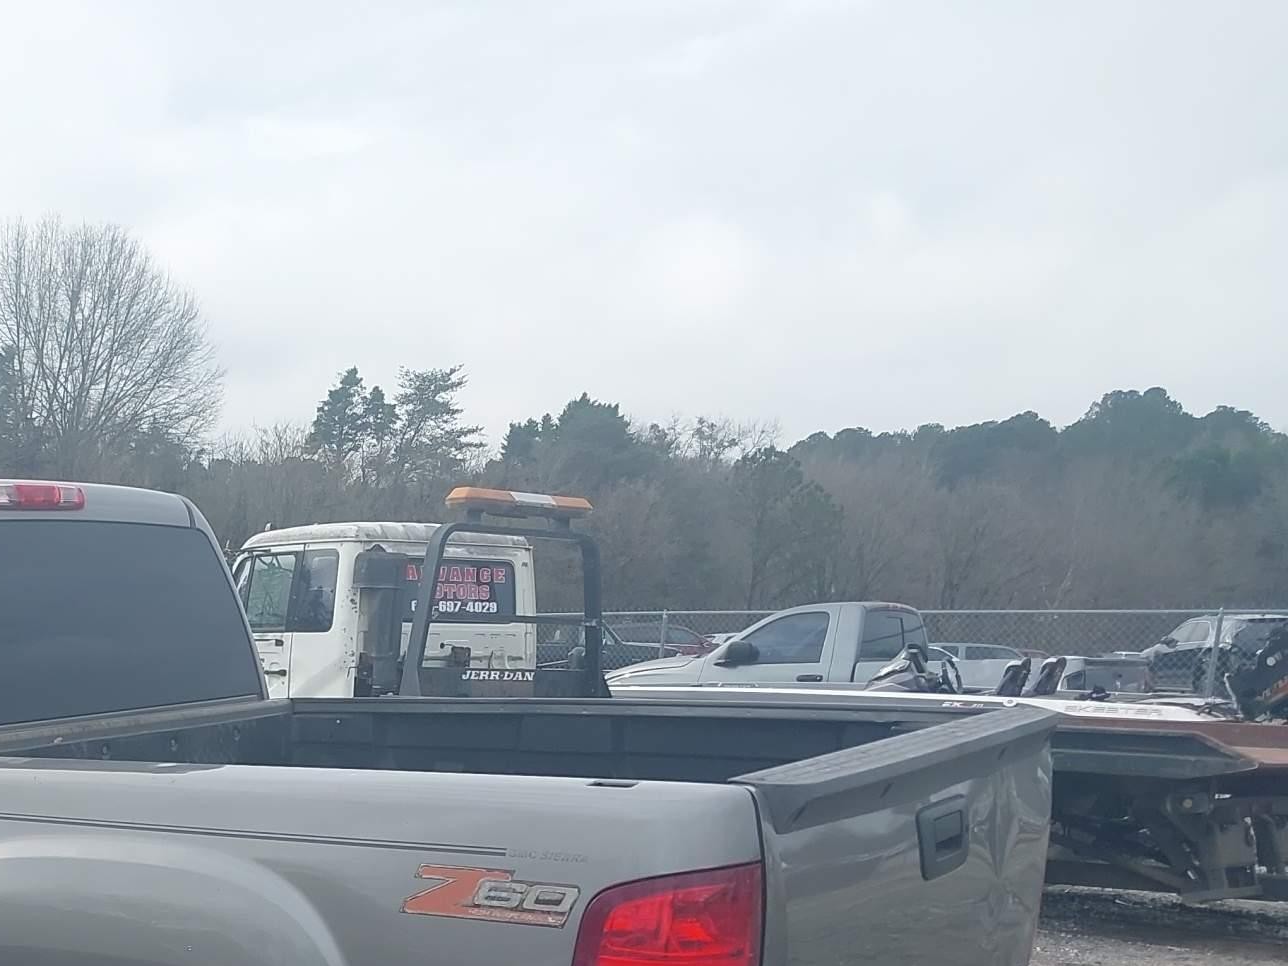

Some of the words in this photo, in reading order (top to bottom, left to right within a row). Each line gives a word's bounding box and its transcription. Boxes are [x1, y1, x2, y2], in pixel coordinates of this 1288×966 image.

[406, 564, 505, 583] AVANCE
[420, 583, 490, 600] OTORS
[400, 863, 581, 929] Z60
